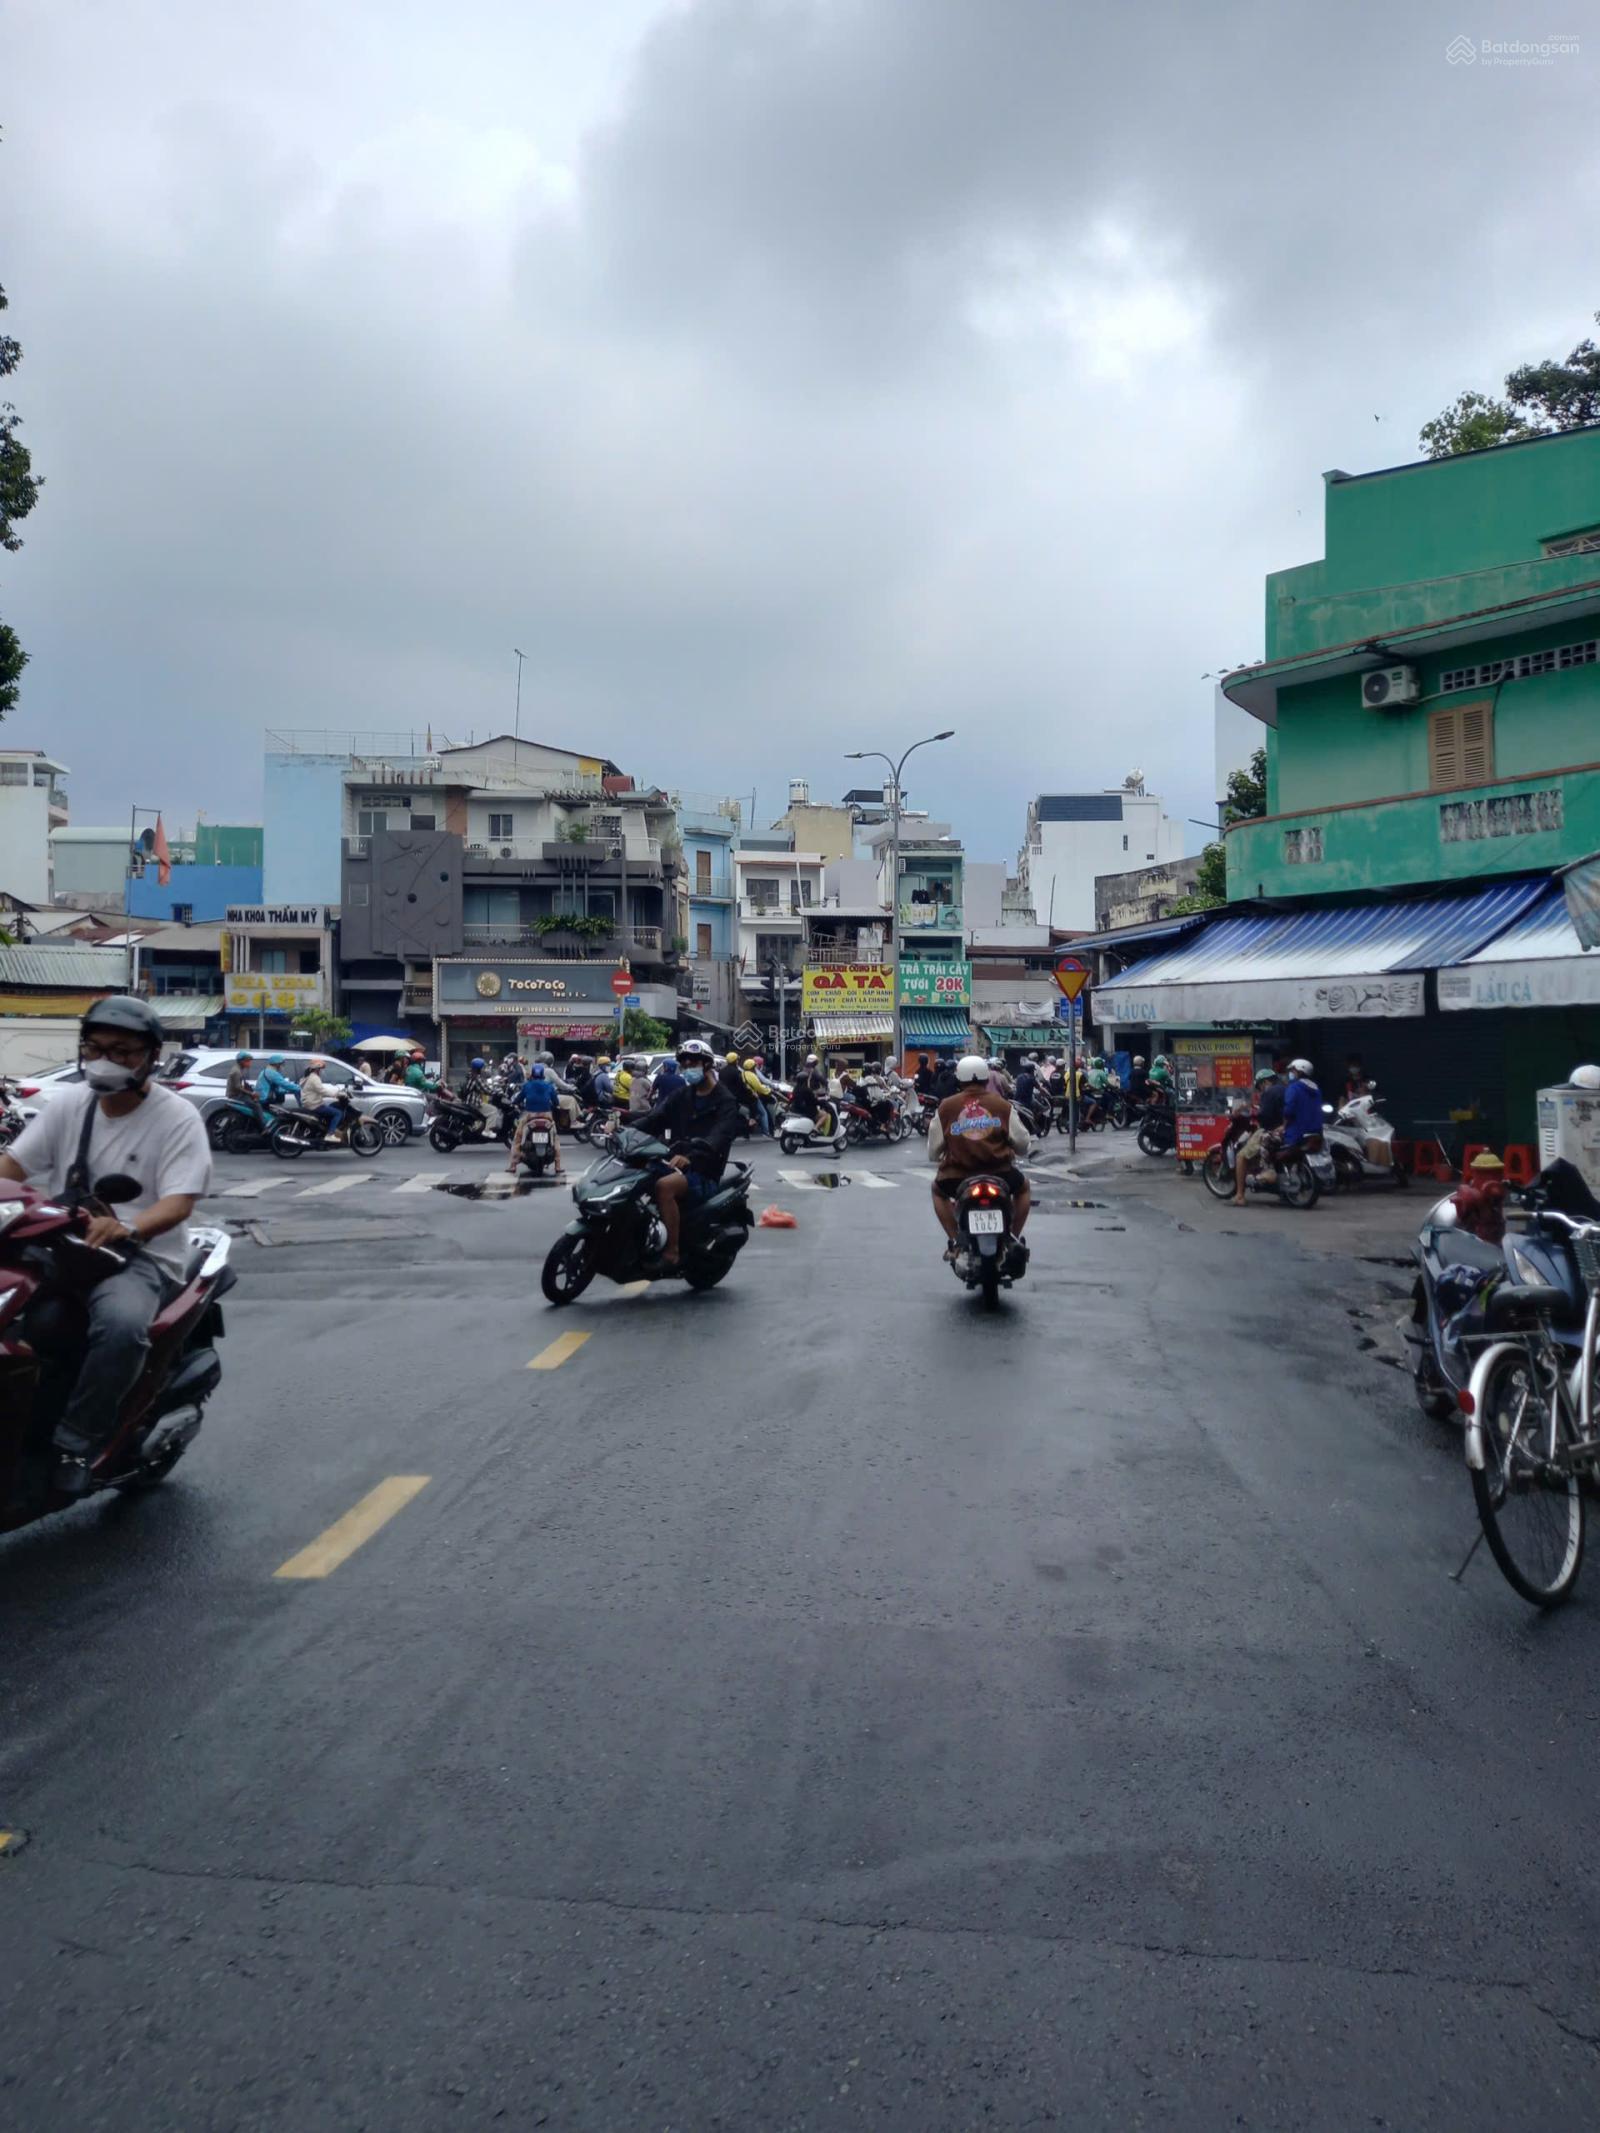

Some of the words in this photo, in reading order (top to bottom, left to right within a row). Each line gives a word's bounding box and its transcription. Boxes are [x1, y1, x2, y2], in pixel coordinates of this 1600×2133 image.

[227, 910, 243, 923] NHA
[244, 910, 265, 923] KHOA
[268, 905, 298, 923] THẨM
[301, 907, 318, 924] MỸ
[900, 962, 920, 975] TRÀ
[923, 962, 946, 975] TRÁI
[949, 962, 969, 975] CÂY
[853, 975, 886, 989] TA
[935, 976, 964, 992] 20K
[1476, 970, 1508, 1004] LẨU
[1511, 975, 1532, 1002] CÁ
[1141, 998, 1157, 1019] CÁ
